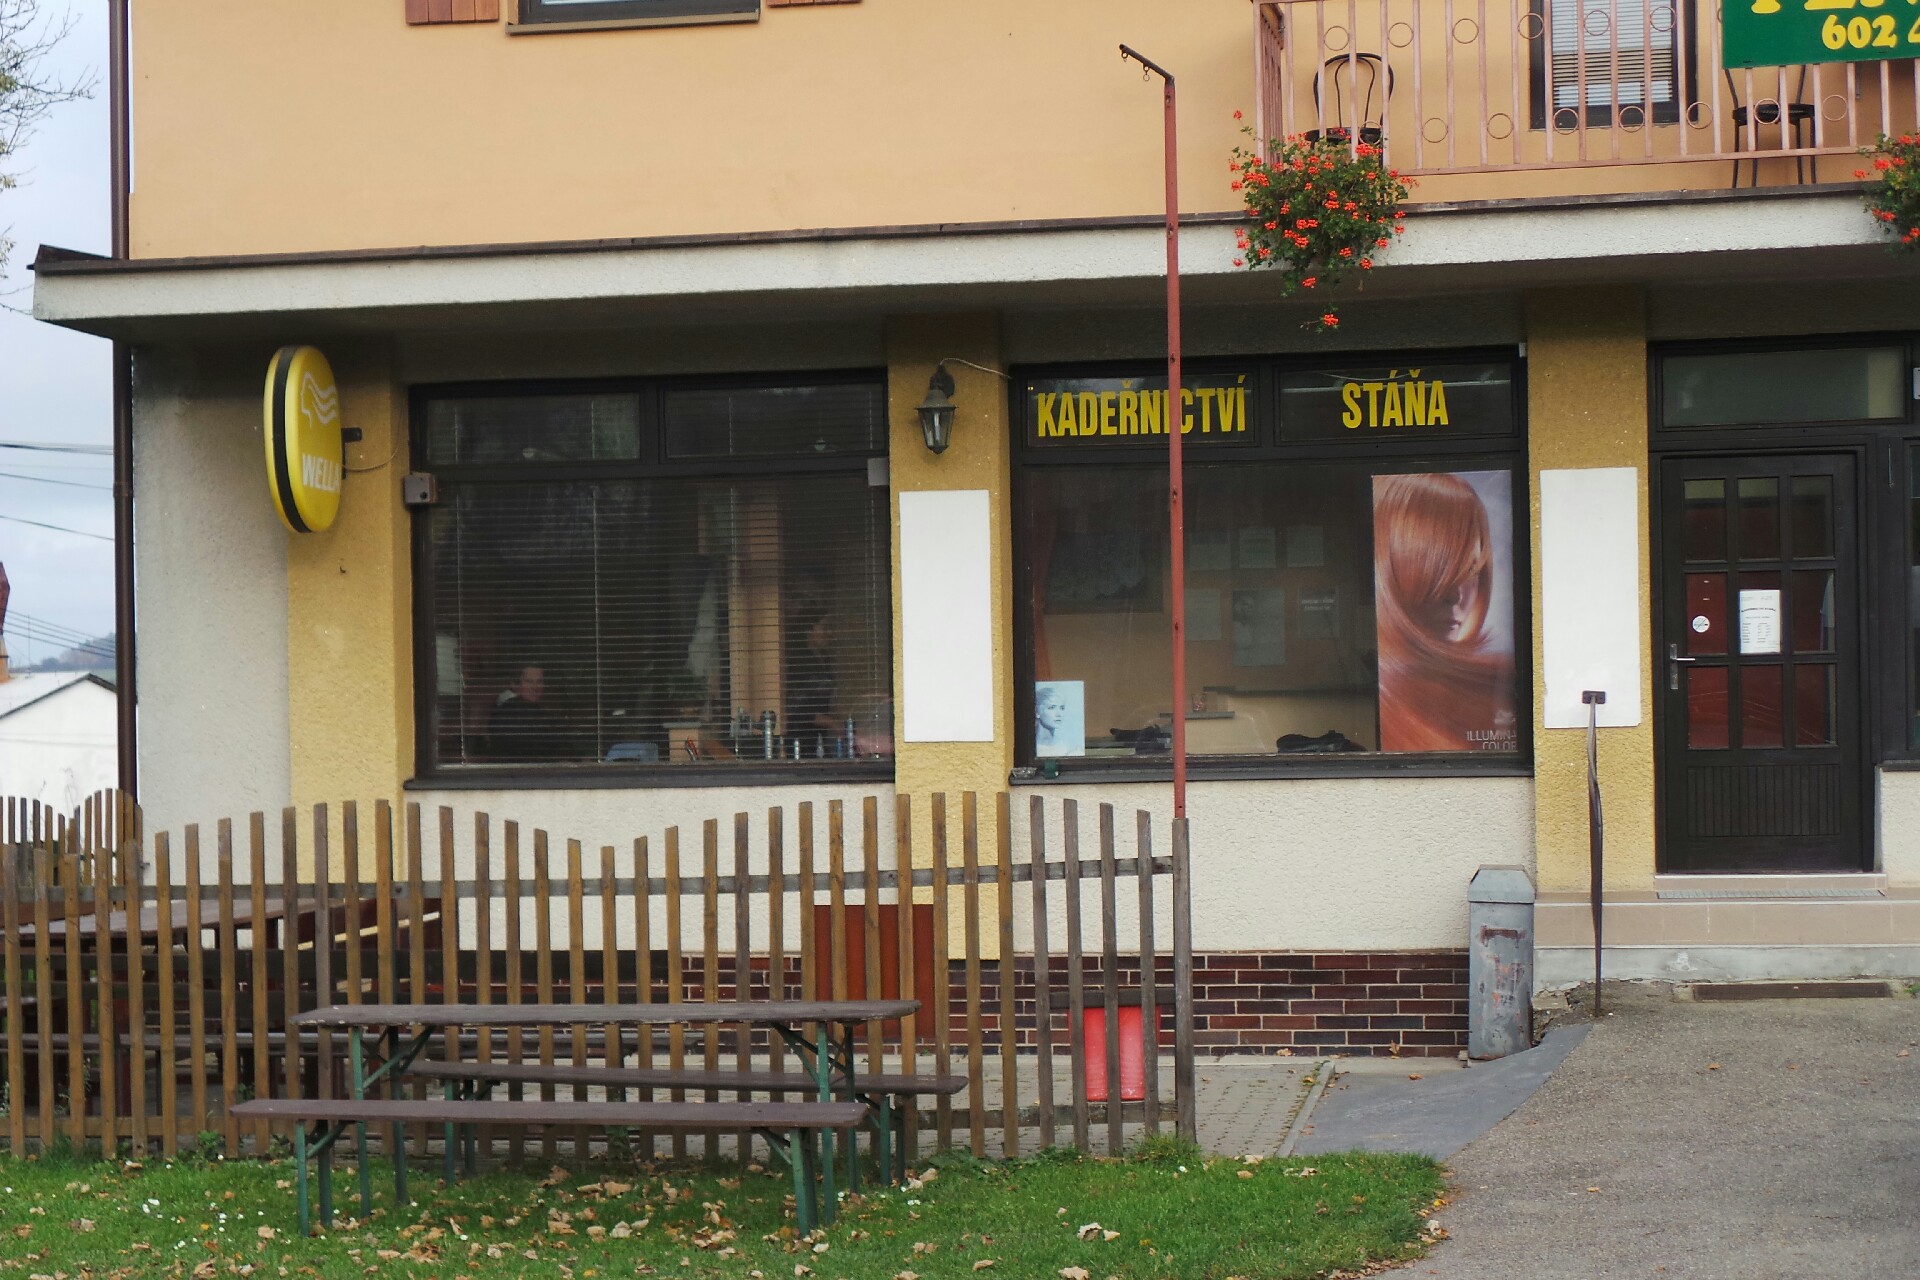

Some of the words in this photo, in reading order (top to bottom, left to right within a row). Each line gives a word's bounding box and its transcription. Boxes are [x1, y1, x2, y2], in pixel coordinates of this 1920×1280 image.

[1822, 14, 1897, 50] 602
[1037, 374, 1246, 437] KADEŘNICTVÍ
[1342, 368, 1449, 429] STÁŇA
[302, 453, 340, 492] WELLA
